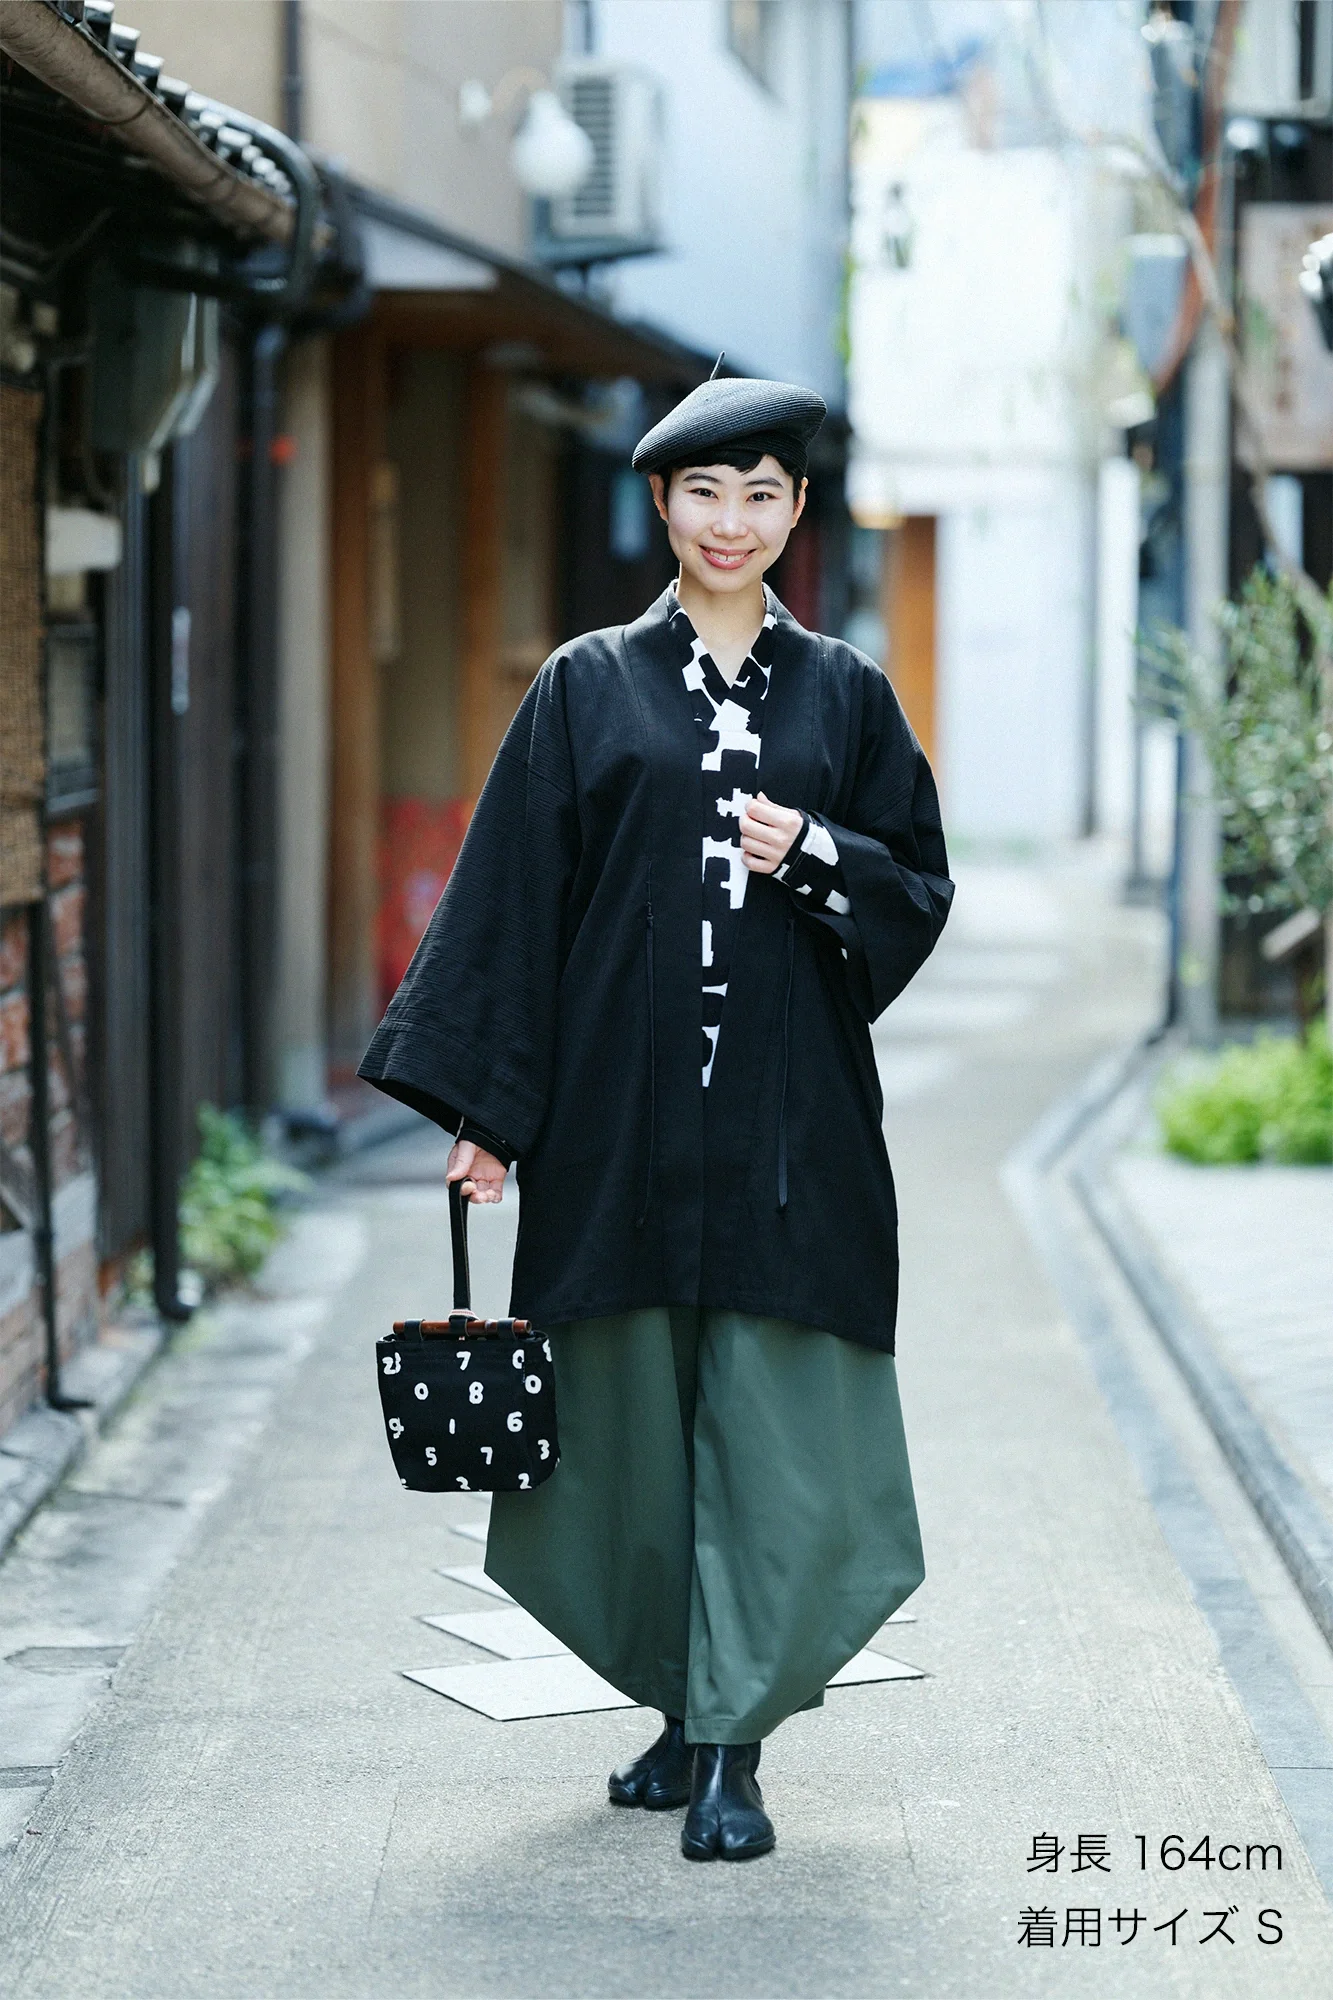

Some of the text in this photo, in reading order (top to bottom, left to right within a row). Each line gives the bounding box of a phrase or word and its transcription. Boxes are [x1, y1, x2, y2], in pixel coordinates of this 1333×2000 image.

[456, 1351, 472, 1371] 7
[414, 1382, 429, 1400] 0
[468, 1381, 484, 1404] 8
[524, 1374, 542, 1394] 0
[506, 1411, 523, 1432] 6
[425, 1446, 438, 1467] 5
[480, 1446, 493, 1465] 7
[537, 1439, 550, 1460] 3
[517, 1473, 532, 1490] 2
